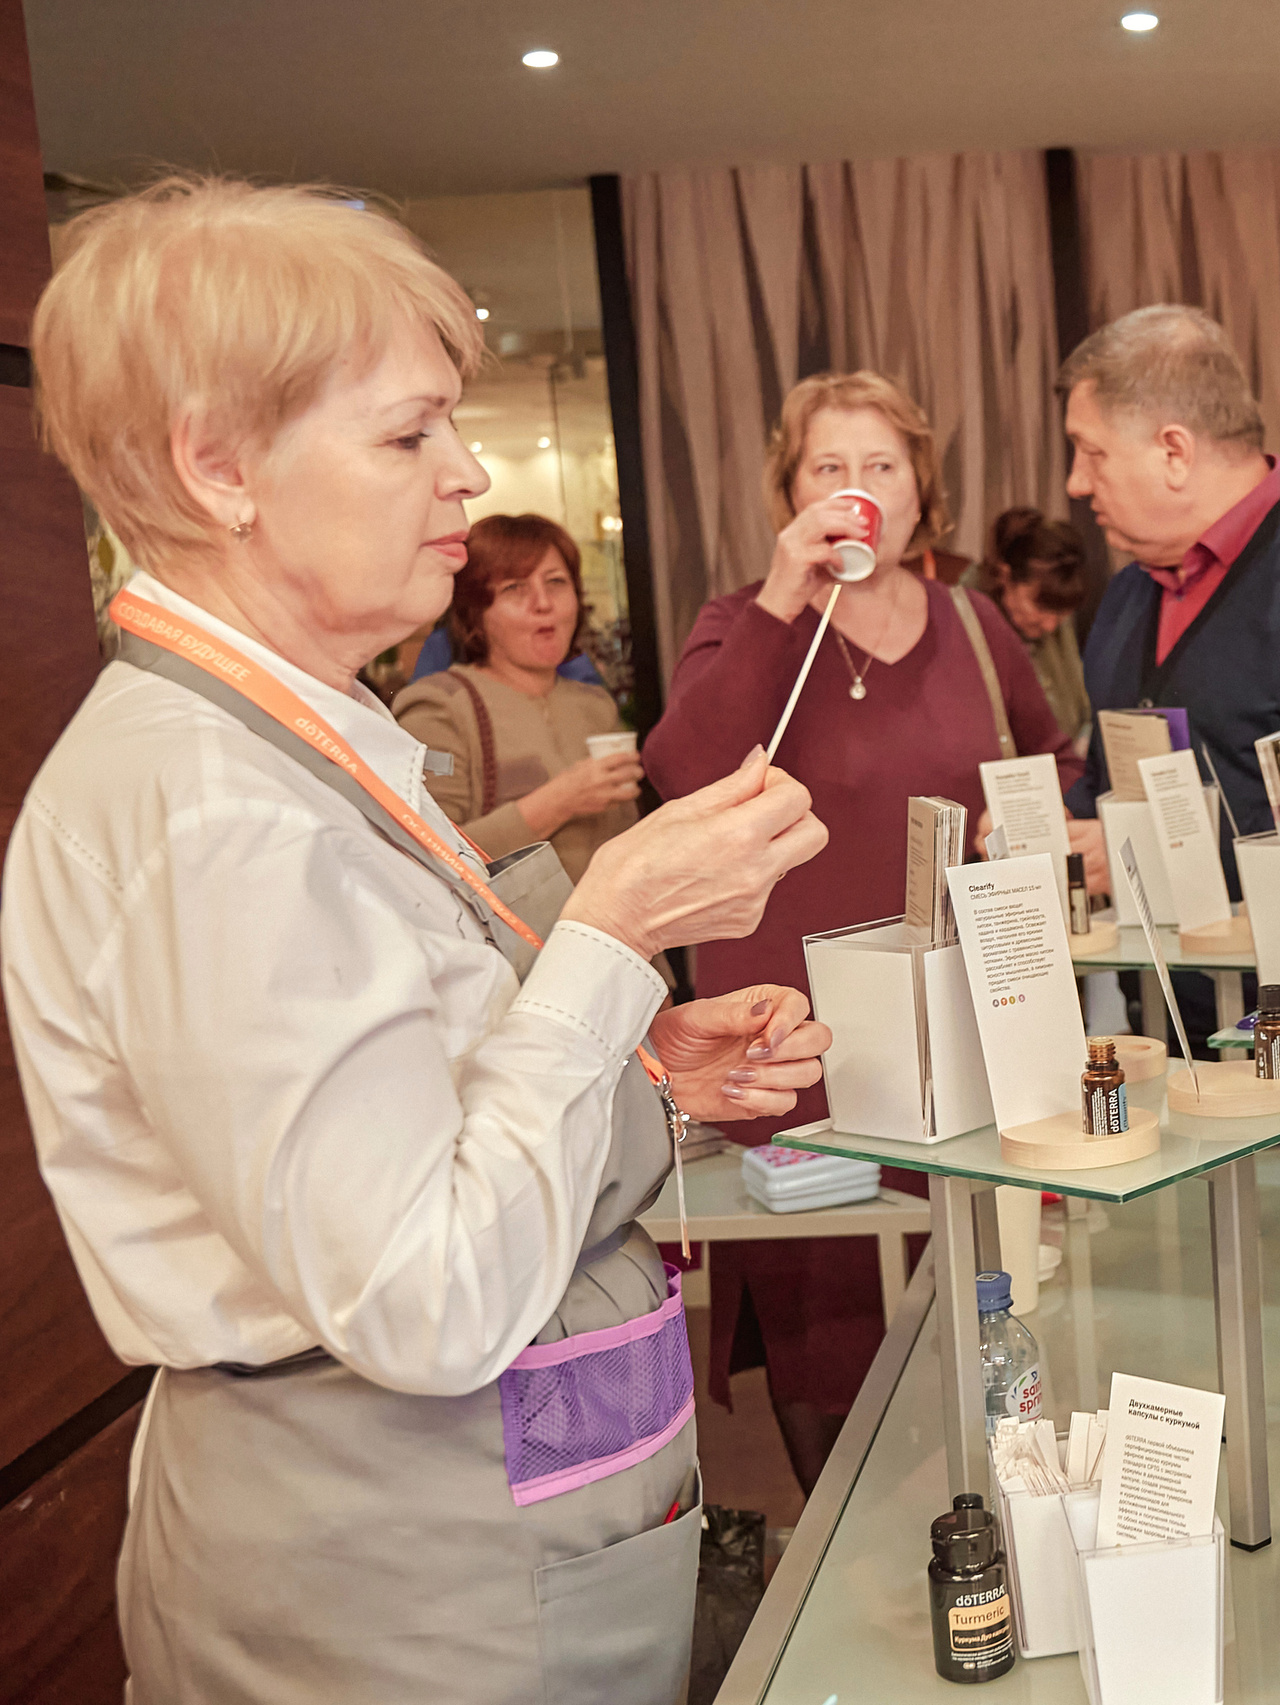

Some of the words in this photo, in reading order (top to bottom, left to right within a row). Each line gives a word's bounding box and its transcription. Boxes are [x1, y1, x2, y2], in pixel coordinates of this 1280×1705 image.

[119, 602, 184, 641] СОЗДАВАЯ
[179, 634, 252, 682] БУДУЩЕЕ
[968, 883, 994, 892] Clearify
[1129, 1399, 1183, 1417] Двухкамерные
[1128, 1409, 1158, 1420] капсулы
[1166, 1417, 1200, 1429] куркумой
[953, 1605, 1005, 1625] Turmeric
